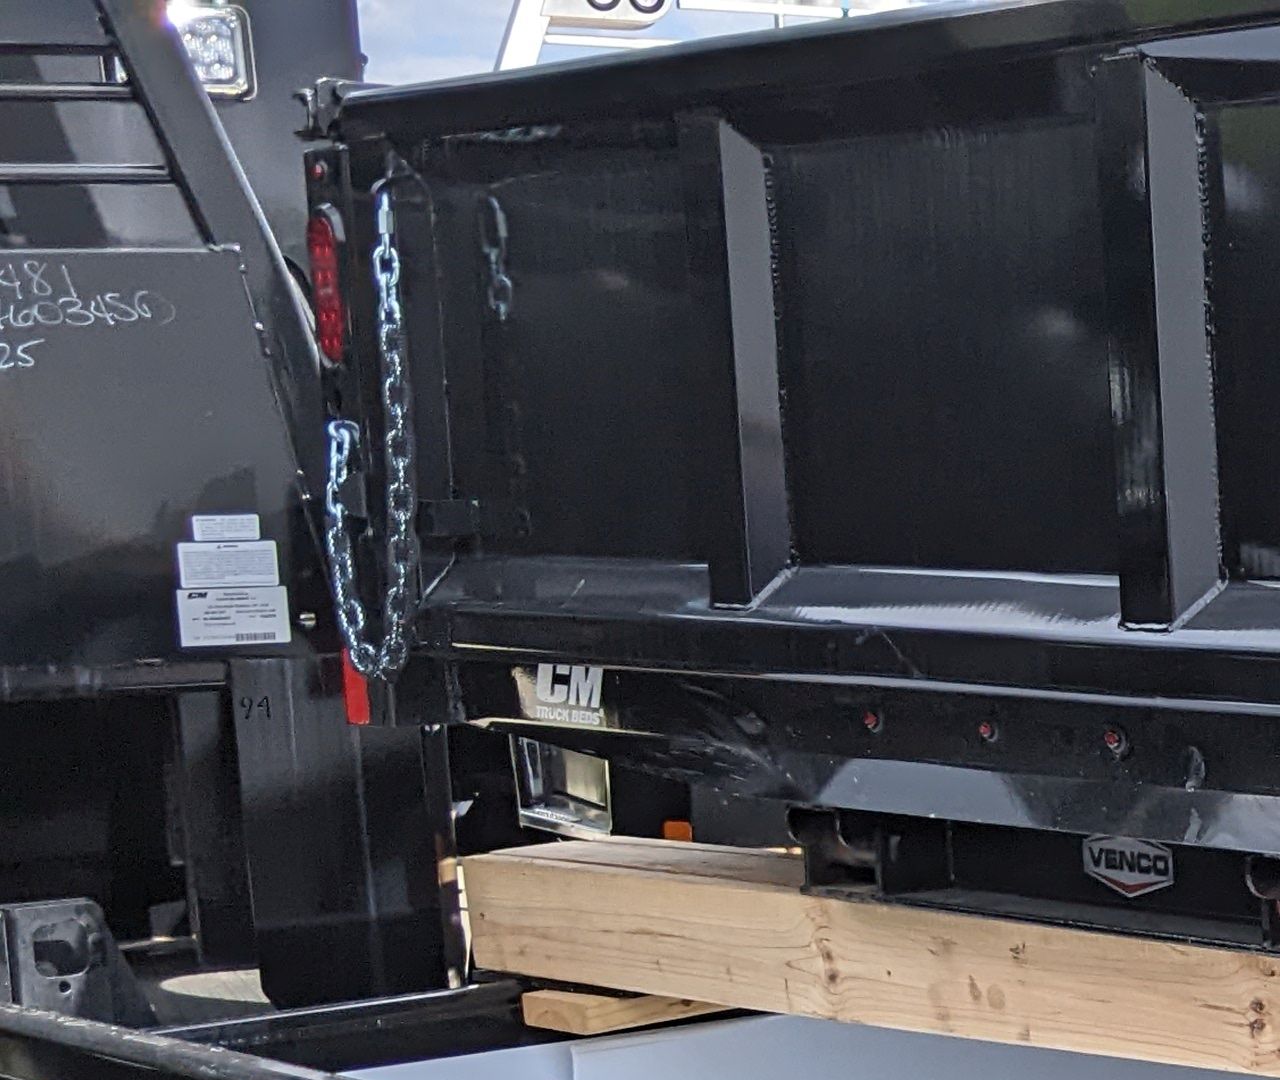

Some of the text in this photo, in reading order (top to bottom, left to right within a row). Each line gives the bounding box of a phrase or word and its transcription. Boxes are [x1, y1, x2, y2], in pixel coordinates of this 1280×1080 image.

[536, 662, 604, 709] CM
[536, 705, 570, 722] TRUCK
[1087, 845, 1170, 877] VENCO
